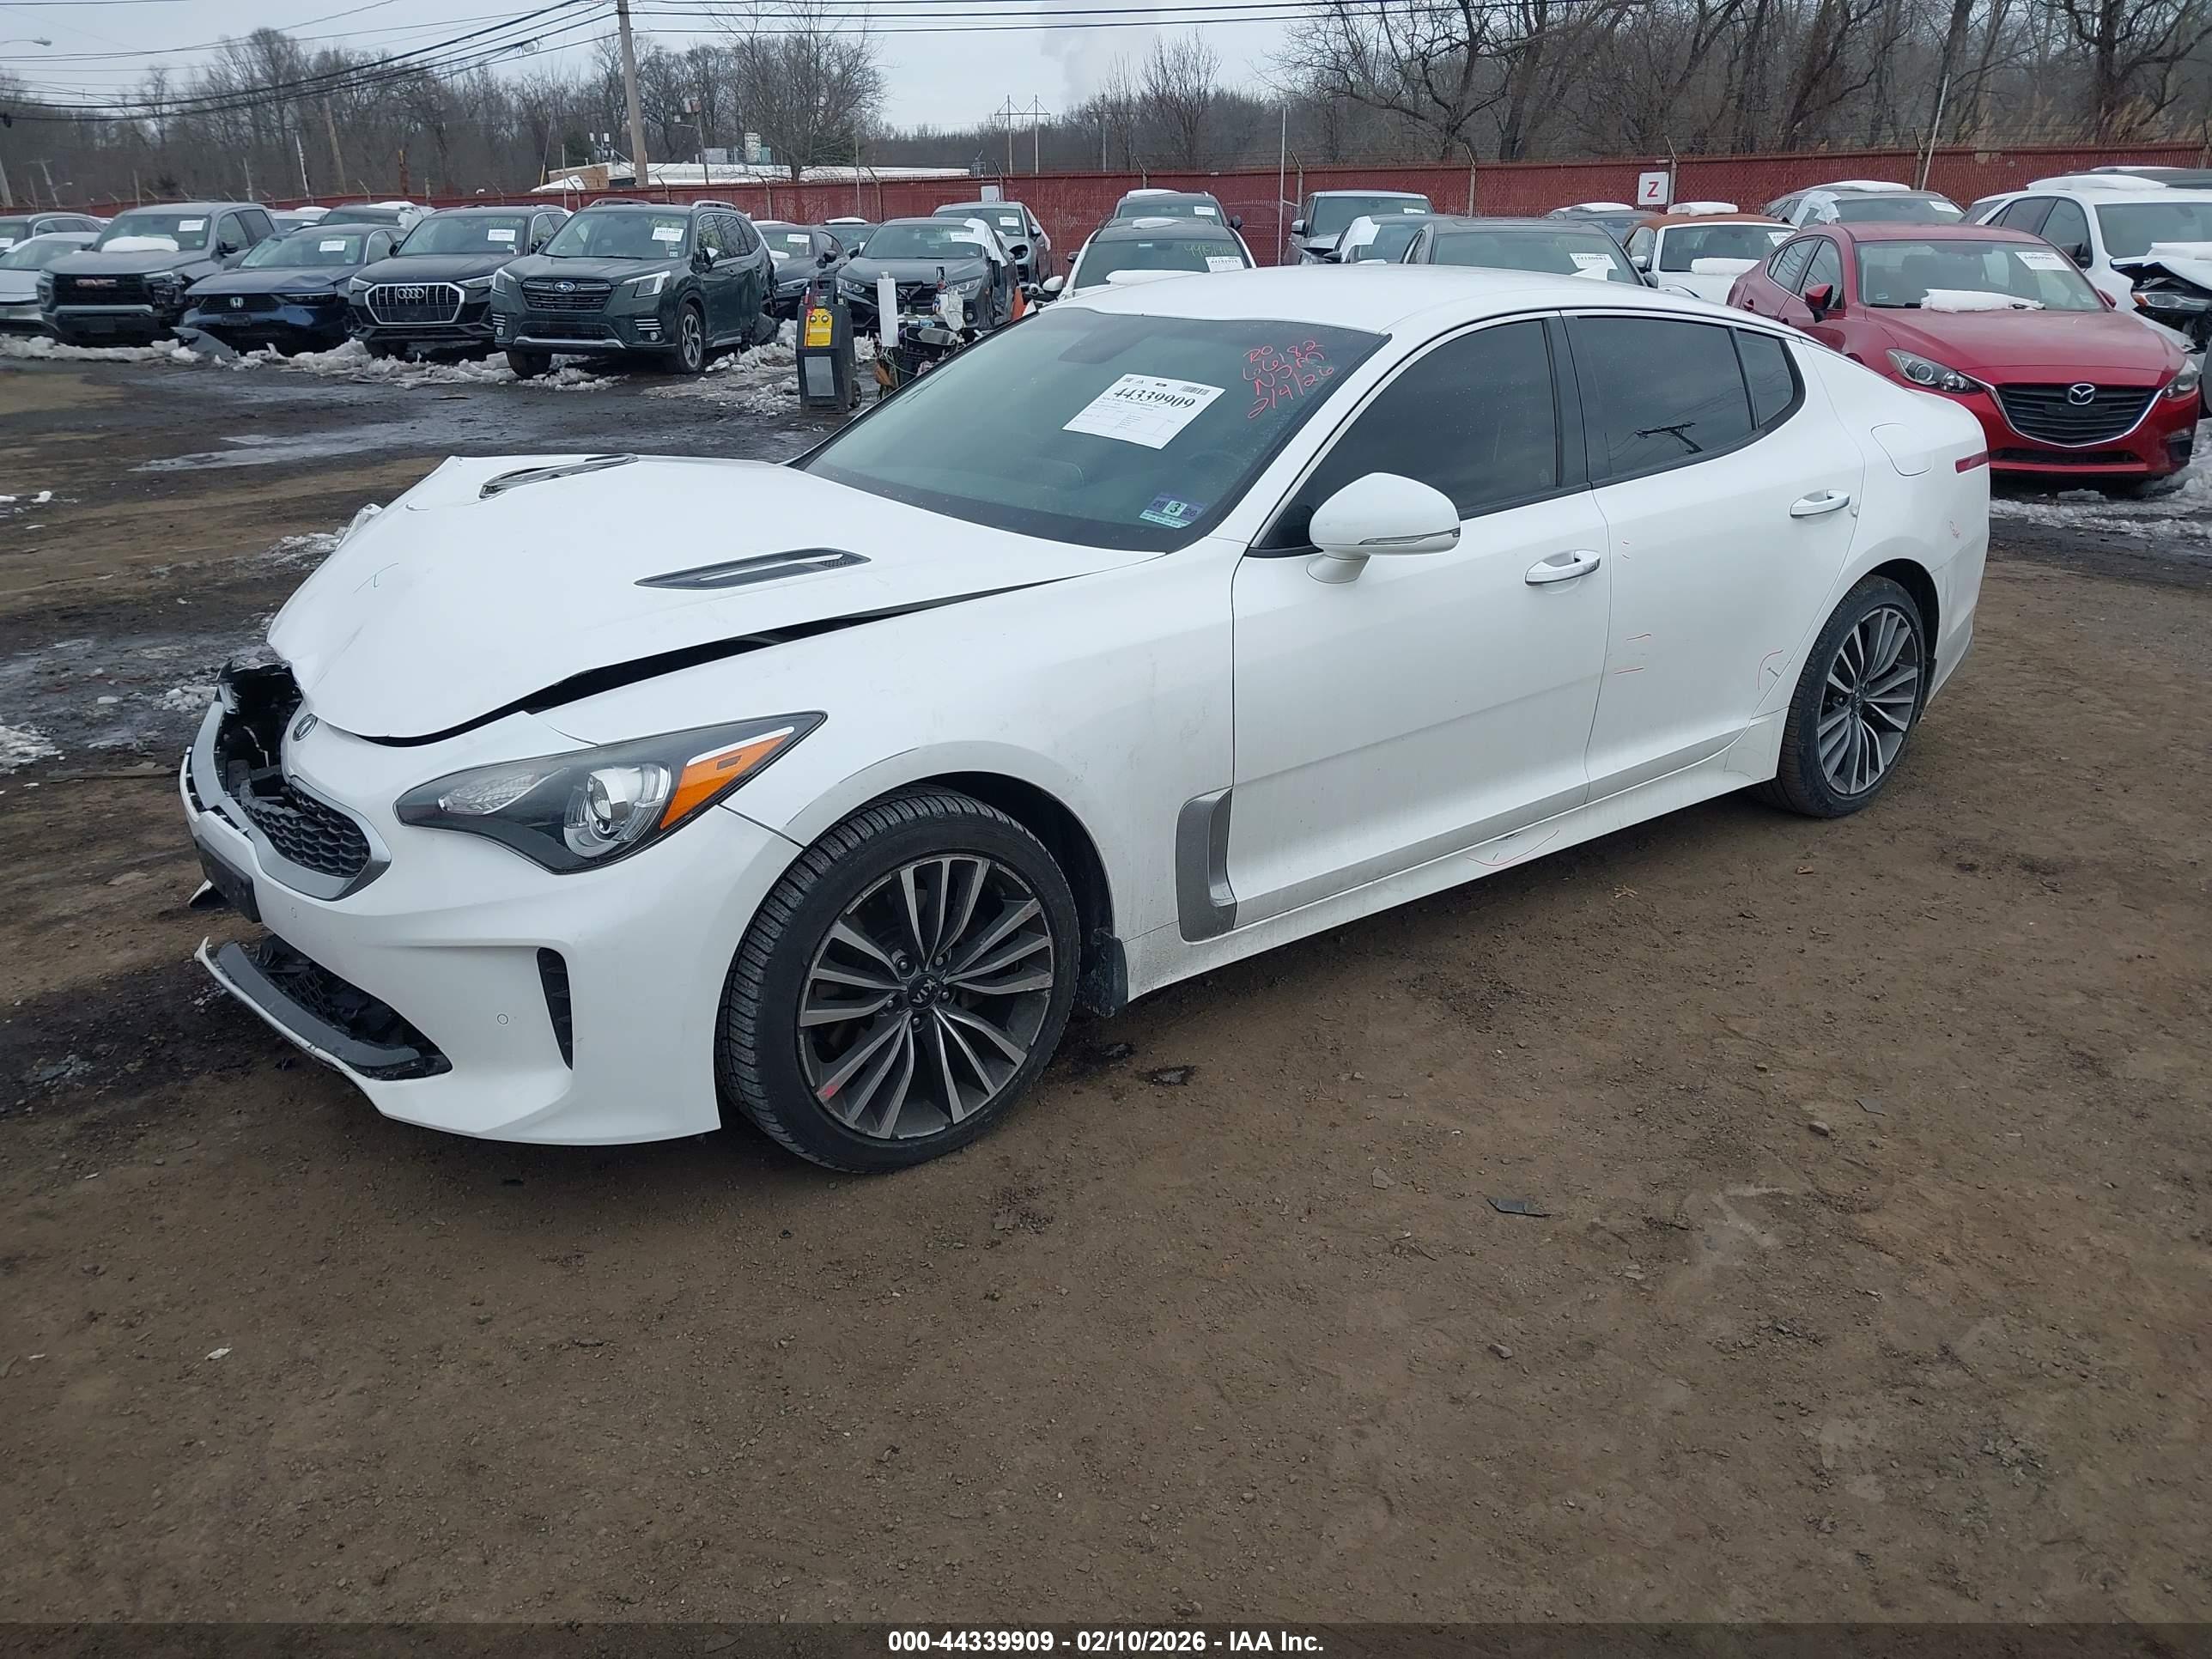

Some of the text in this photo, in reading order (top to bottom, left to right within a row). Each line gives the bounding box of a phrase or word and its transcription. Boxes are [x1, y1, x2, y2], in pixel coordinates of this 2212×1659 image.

[1647, 181, 1659, 198] Z
[1114, 387, 1196, 409] 44339909
[1170, 502, 1181, 514] 3
